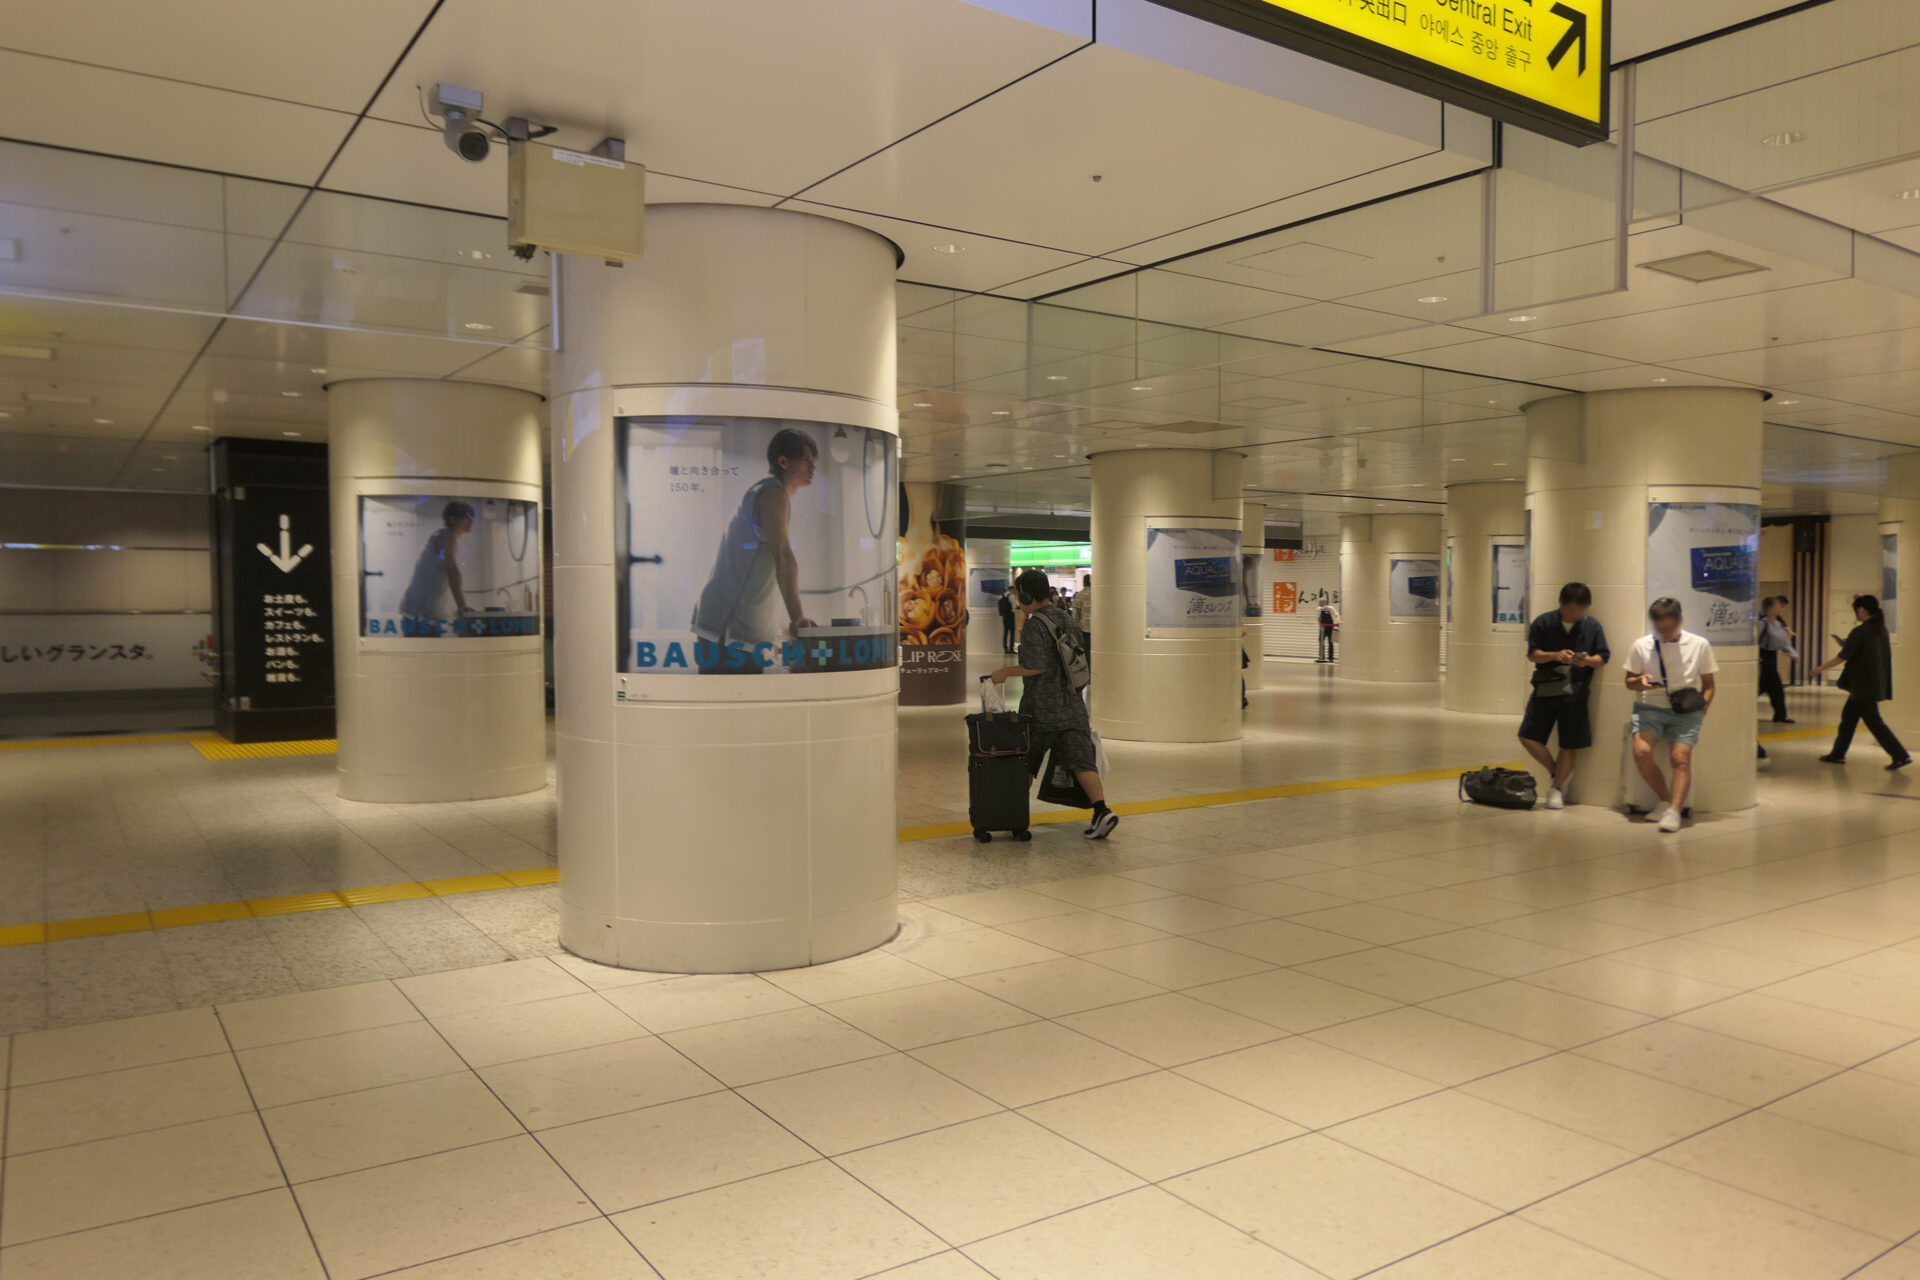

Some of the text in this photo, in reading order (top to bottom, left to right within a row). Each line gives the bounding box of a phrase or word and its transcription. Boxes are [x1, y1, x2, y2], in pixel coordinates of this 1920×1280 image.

[1339, 0, 1407, 25] 央出口
[1437, 0, 1532, 42] entral Exit
[1420, 14, 1532, 72] 야에스 중앙 출구
[369, 618, 468, 635] BAUSCH
[636, 641, 804, 668] BAUSCH
